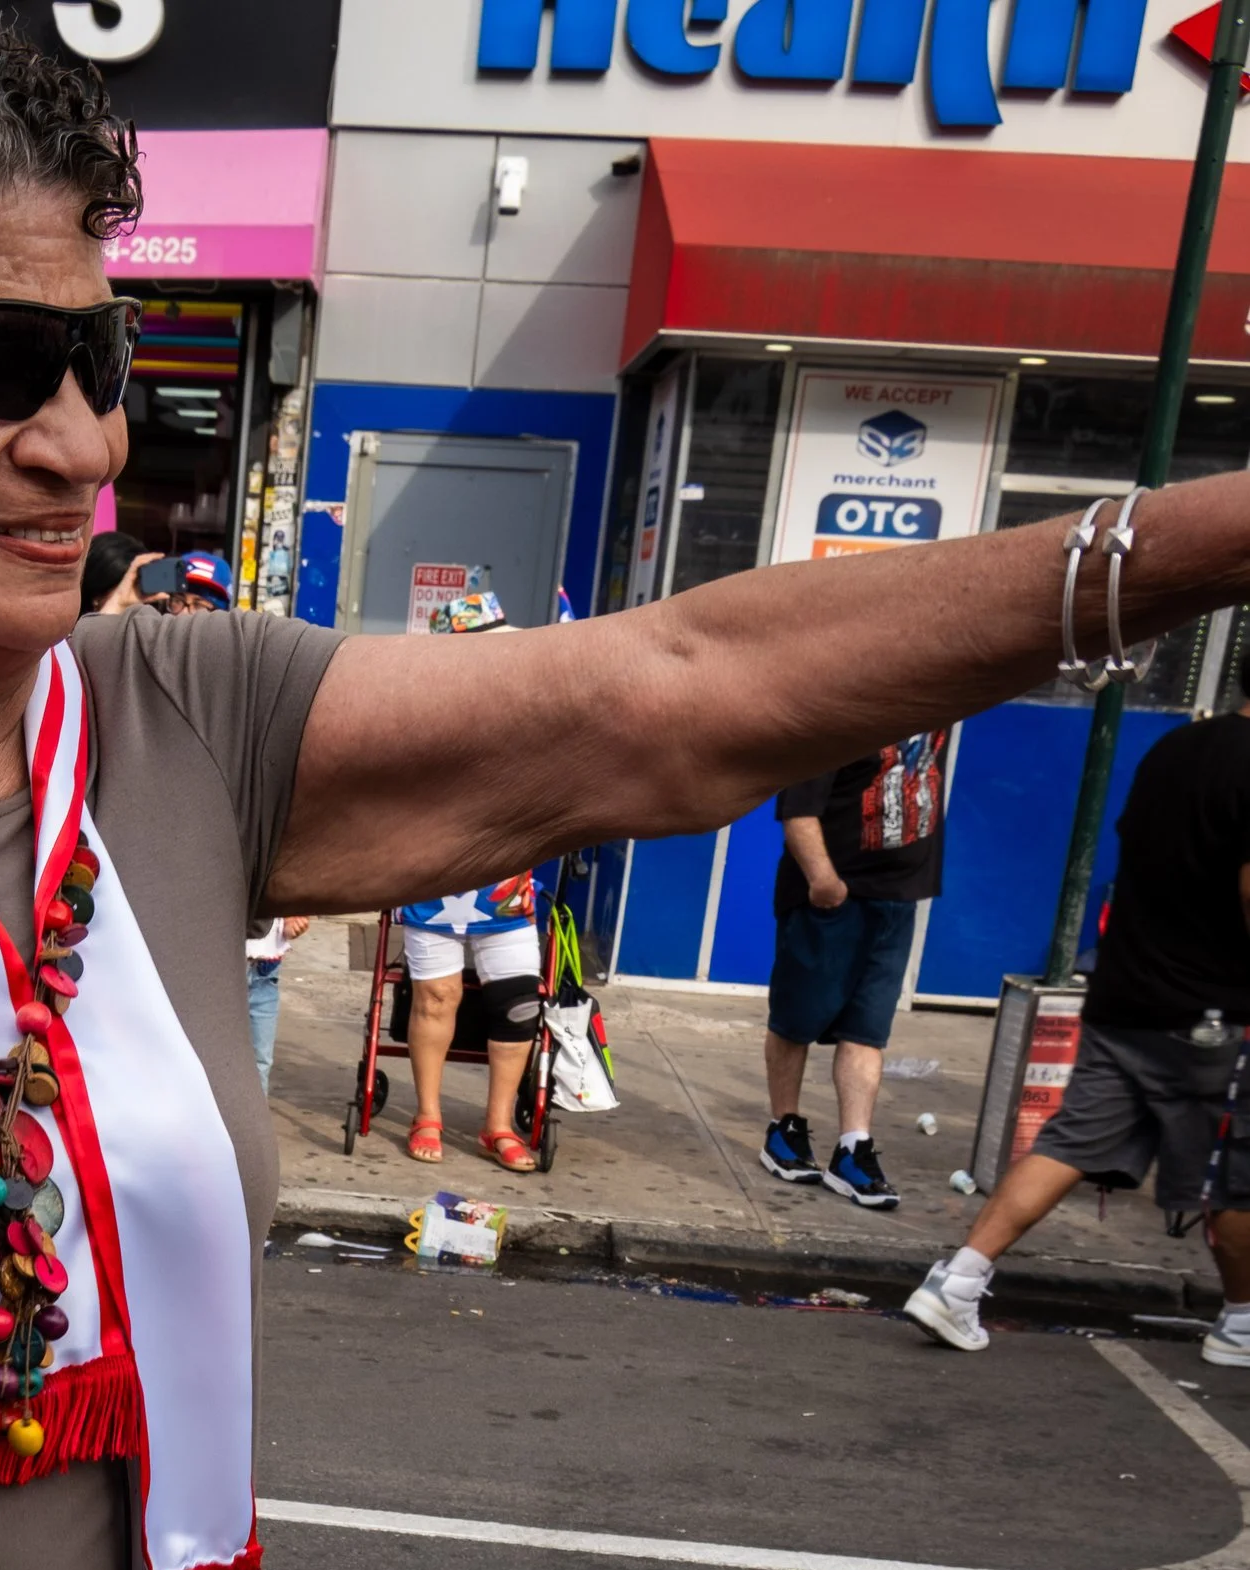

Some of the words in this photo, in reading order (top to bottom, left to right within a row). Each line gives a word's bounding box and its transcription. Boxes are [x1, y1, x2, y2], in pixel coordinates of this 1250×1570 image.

[845, 384, 872, 400] WE
[877, 386, 953, 406] ACCEPT
[833, 472, 937, 490] merchant
[835, 499, 922, 535] OTC
[417, 568, 440, 585] FIRE
[440, 569, 465, 586] EXIT
[417, 589, 434, 601] DO
[1023, 1090, 1051, 1104] B63
